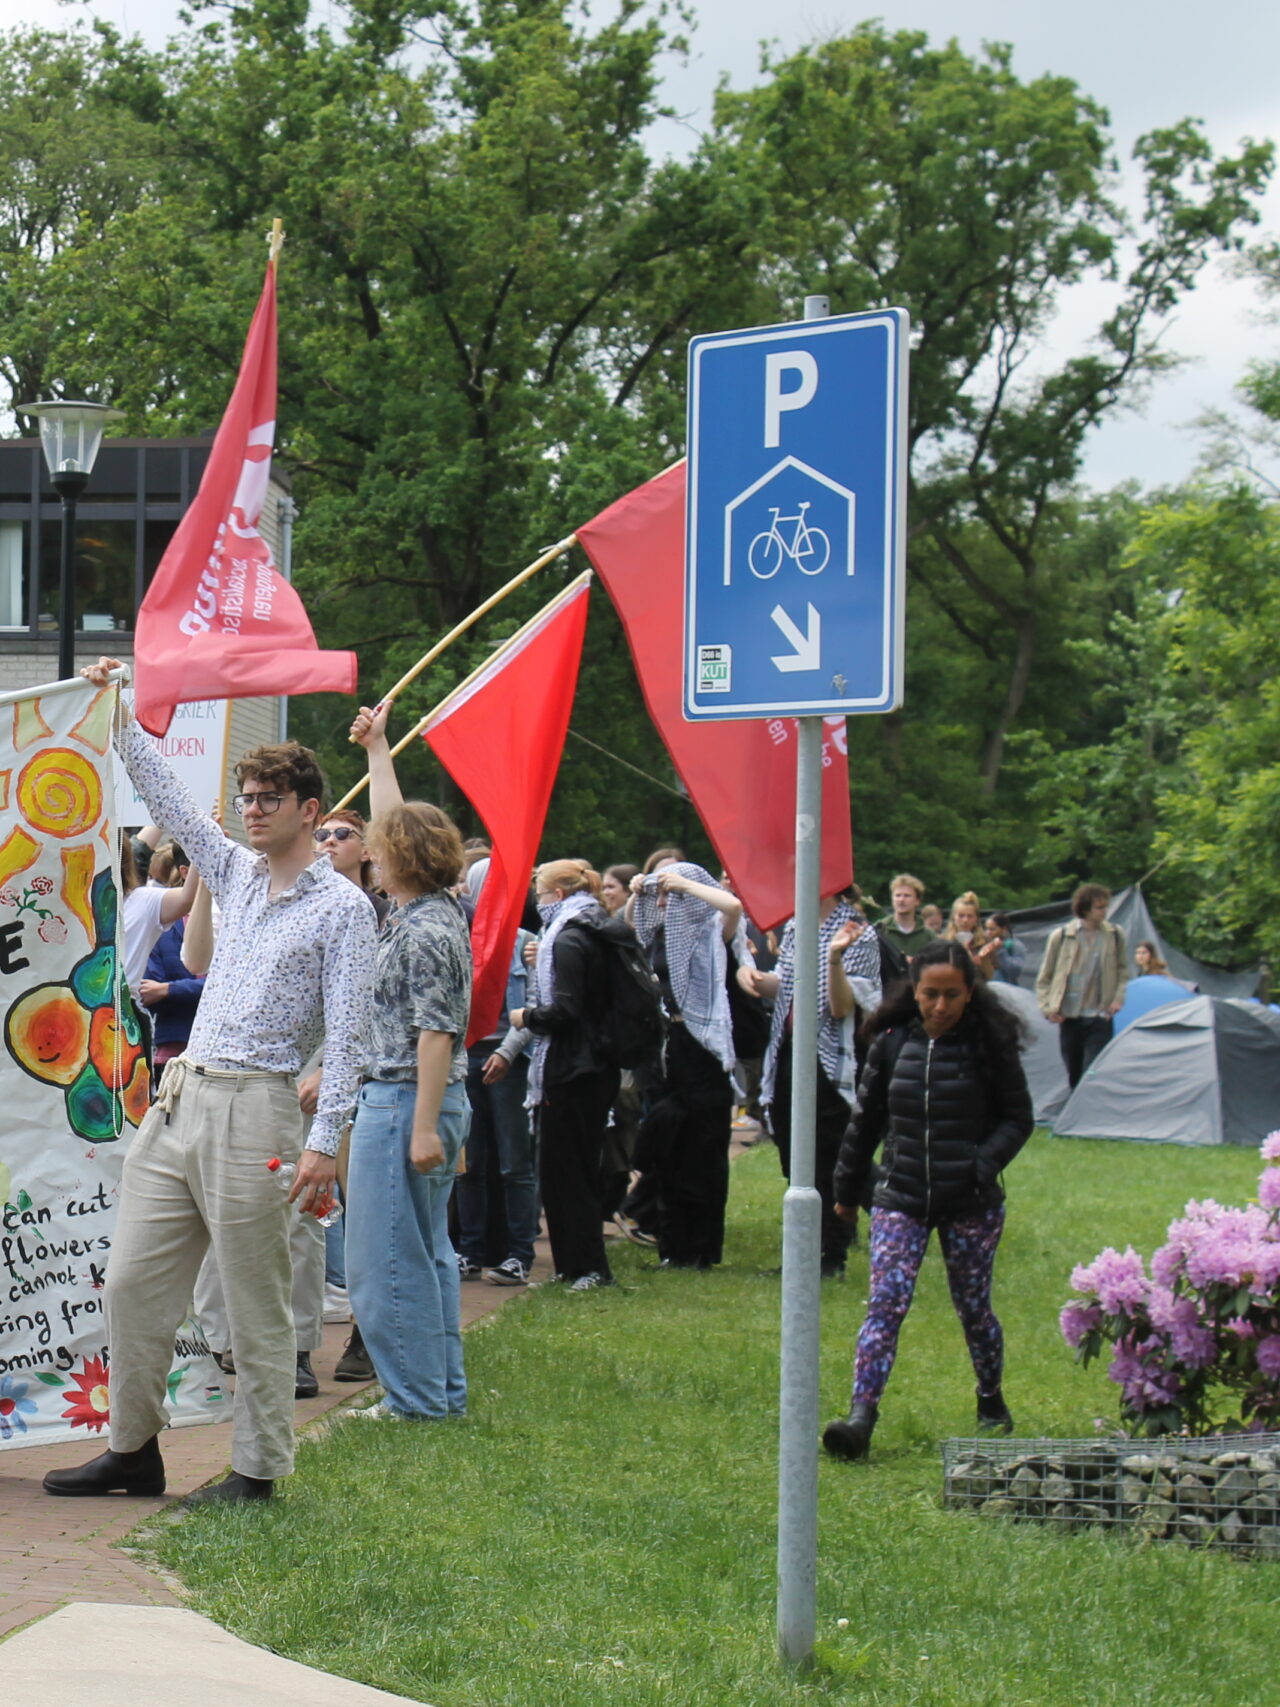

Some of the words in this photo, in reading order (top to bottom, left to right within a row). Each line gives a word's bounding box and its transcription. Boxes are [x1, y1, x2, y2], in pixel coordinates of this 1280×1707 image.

[764, 350, 819, 449] P
[701, 663, 727, 679] KUT
[67, 1182, 112, 1217] cut
[2, 1235, 111, 1281] flowers
[9, 1265, 78, 1302] cannot
[61, 1298, 102, 1334] fro
